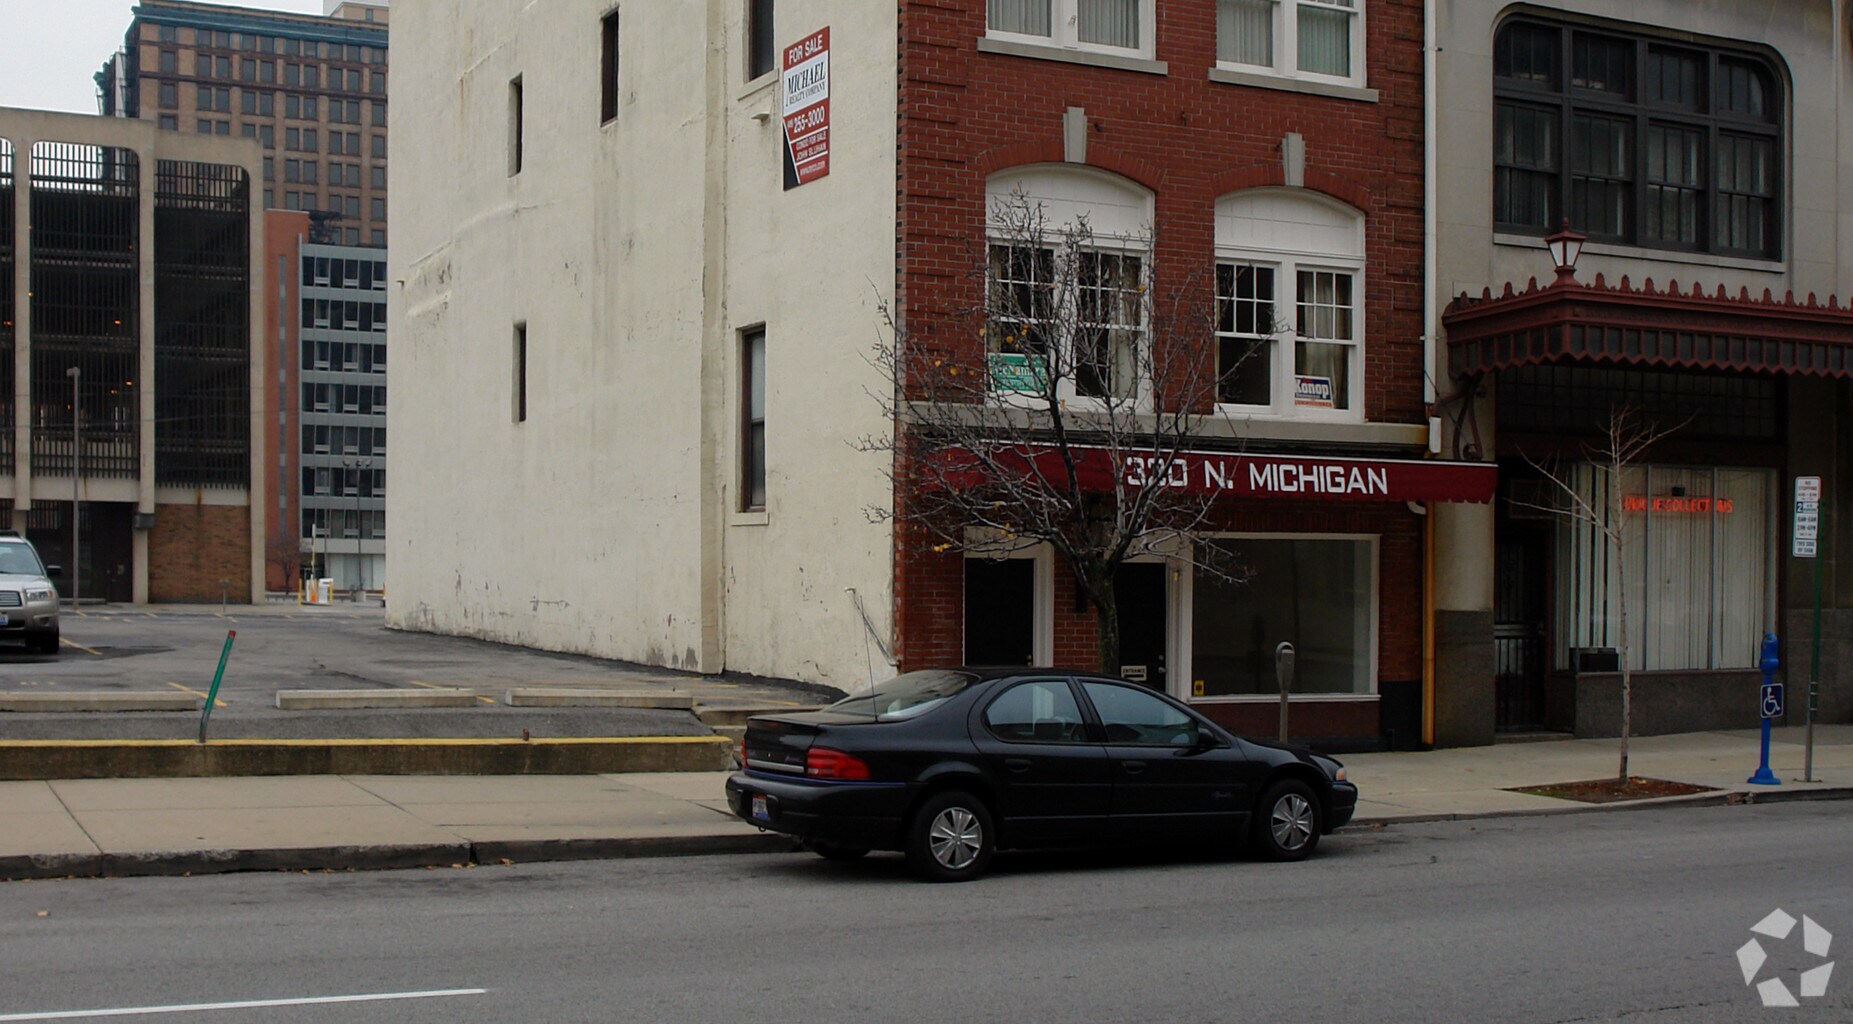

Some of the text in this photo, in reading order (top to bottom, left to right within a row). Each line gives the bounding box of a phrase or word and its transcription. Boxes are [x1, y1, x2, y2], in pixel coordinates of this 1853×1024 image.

[788, 34, 823, 65] FOR SALE
[788, 61, 826, 94] MICHAEL
[1295, 379, 1329, 399] Konop
[1204, 459, 1234, 489] N.
[1249, 462, 1388, 495] MICHIGAN
[1797, 502, 1802, 512] 2
